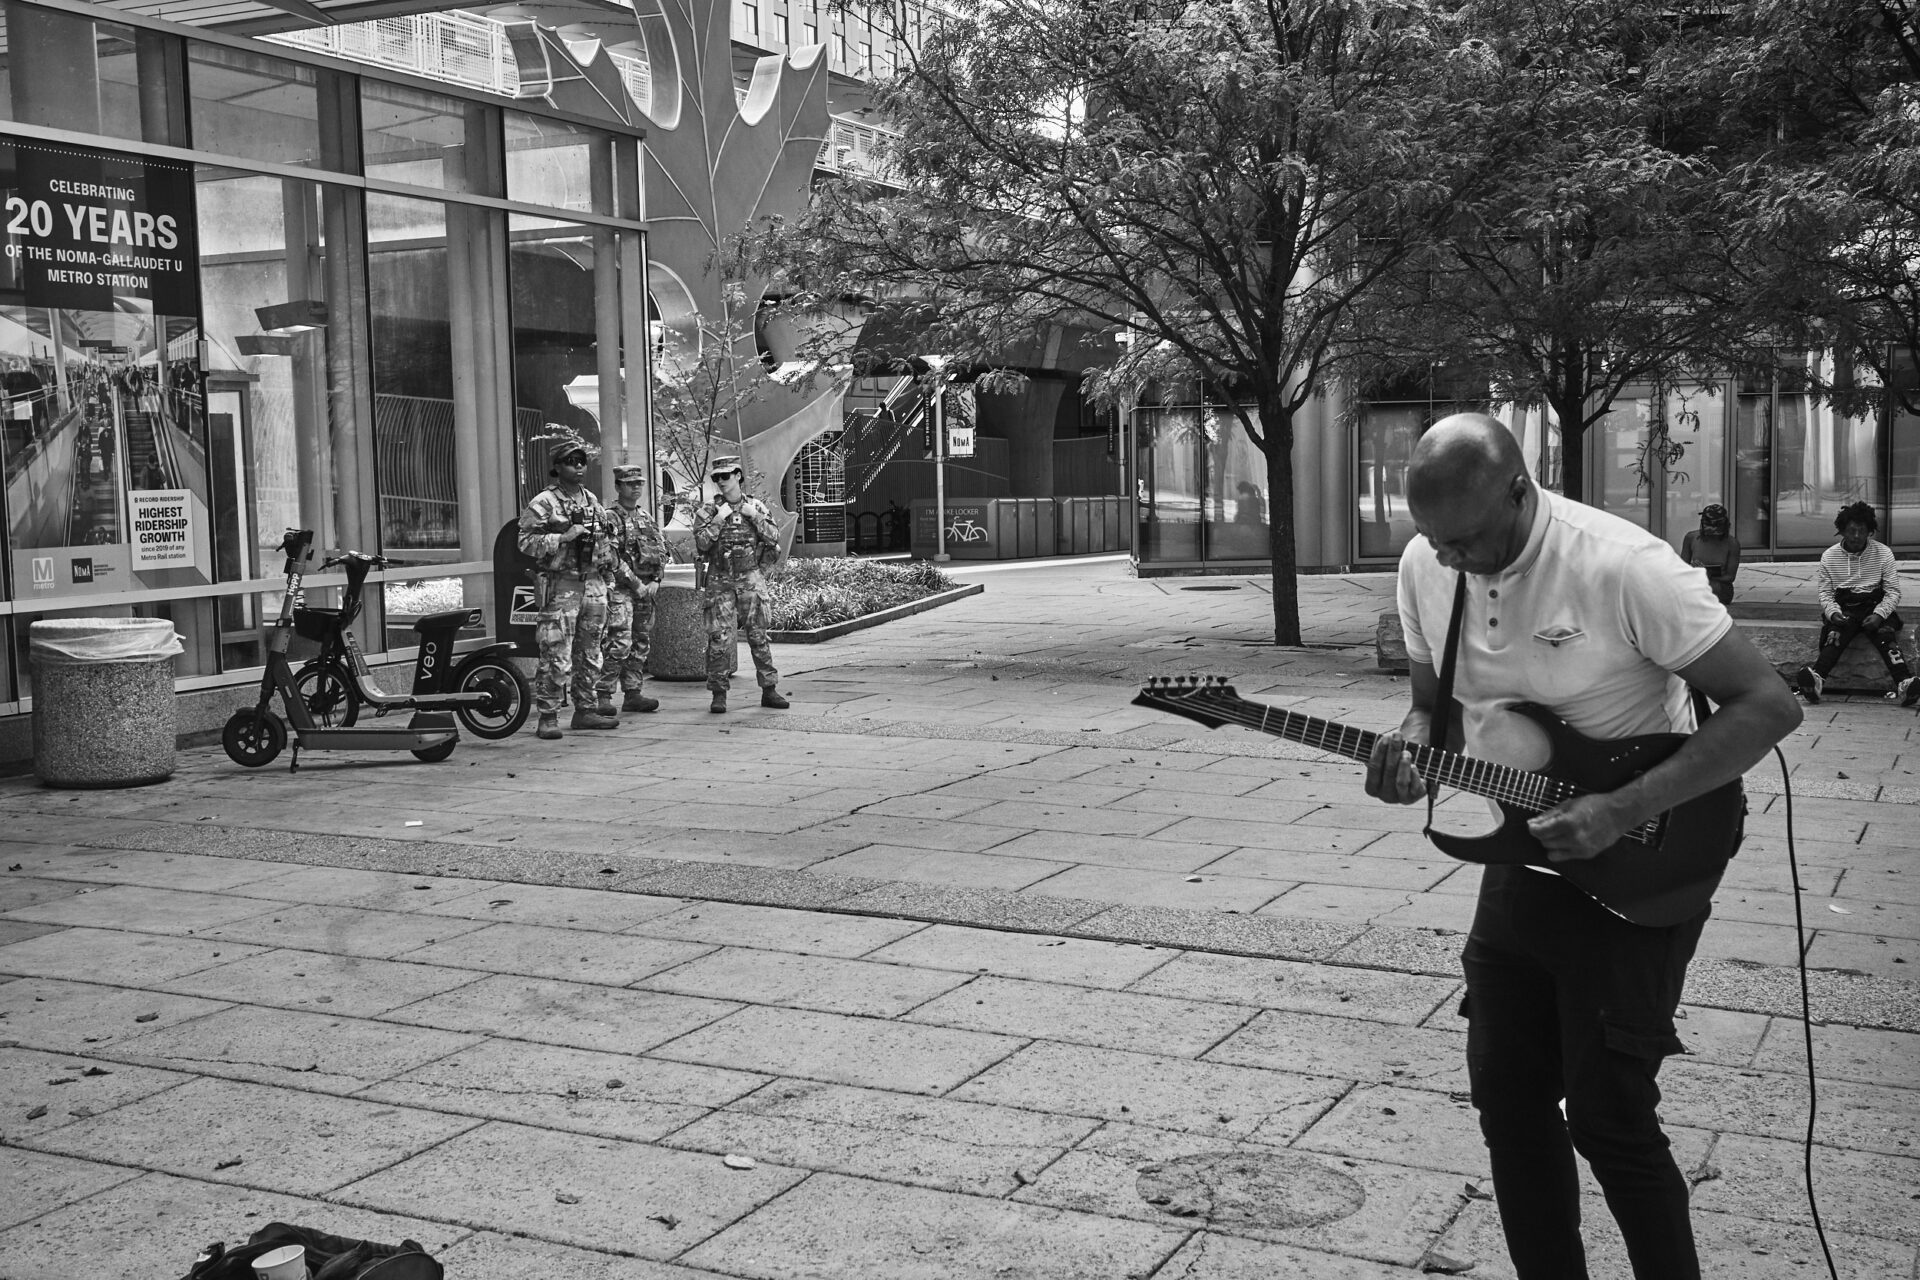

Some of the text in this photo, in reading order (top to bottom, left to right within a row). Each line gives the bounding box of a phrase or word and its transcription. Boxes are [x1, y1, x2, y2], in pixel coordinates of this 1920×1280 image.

[49, 179, 136, 202] CELEBRATING
[4, 196, 178, 250] 20 YEARS
[4, 244, 183, 272] OF THE NOMA-GALLAUDET U
[47, 268, 149, 289] METRO STATION
[138, 506, 183, 519] HIGHEST
[955, 508, 979, 516] LOCKER
[135, 518, 188, 532] RIDERSHIP
[139, 531, 185, 544] GROWTH
[34, 559, 53, 581] M
[33, 582, 55, 590] metro
[286, 573, 300, 596] Hopp
[420, 641, 437, 680] veo
